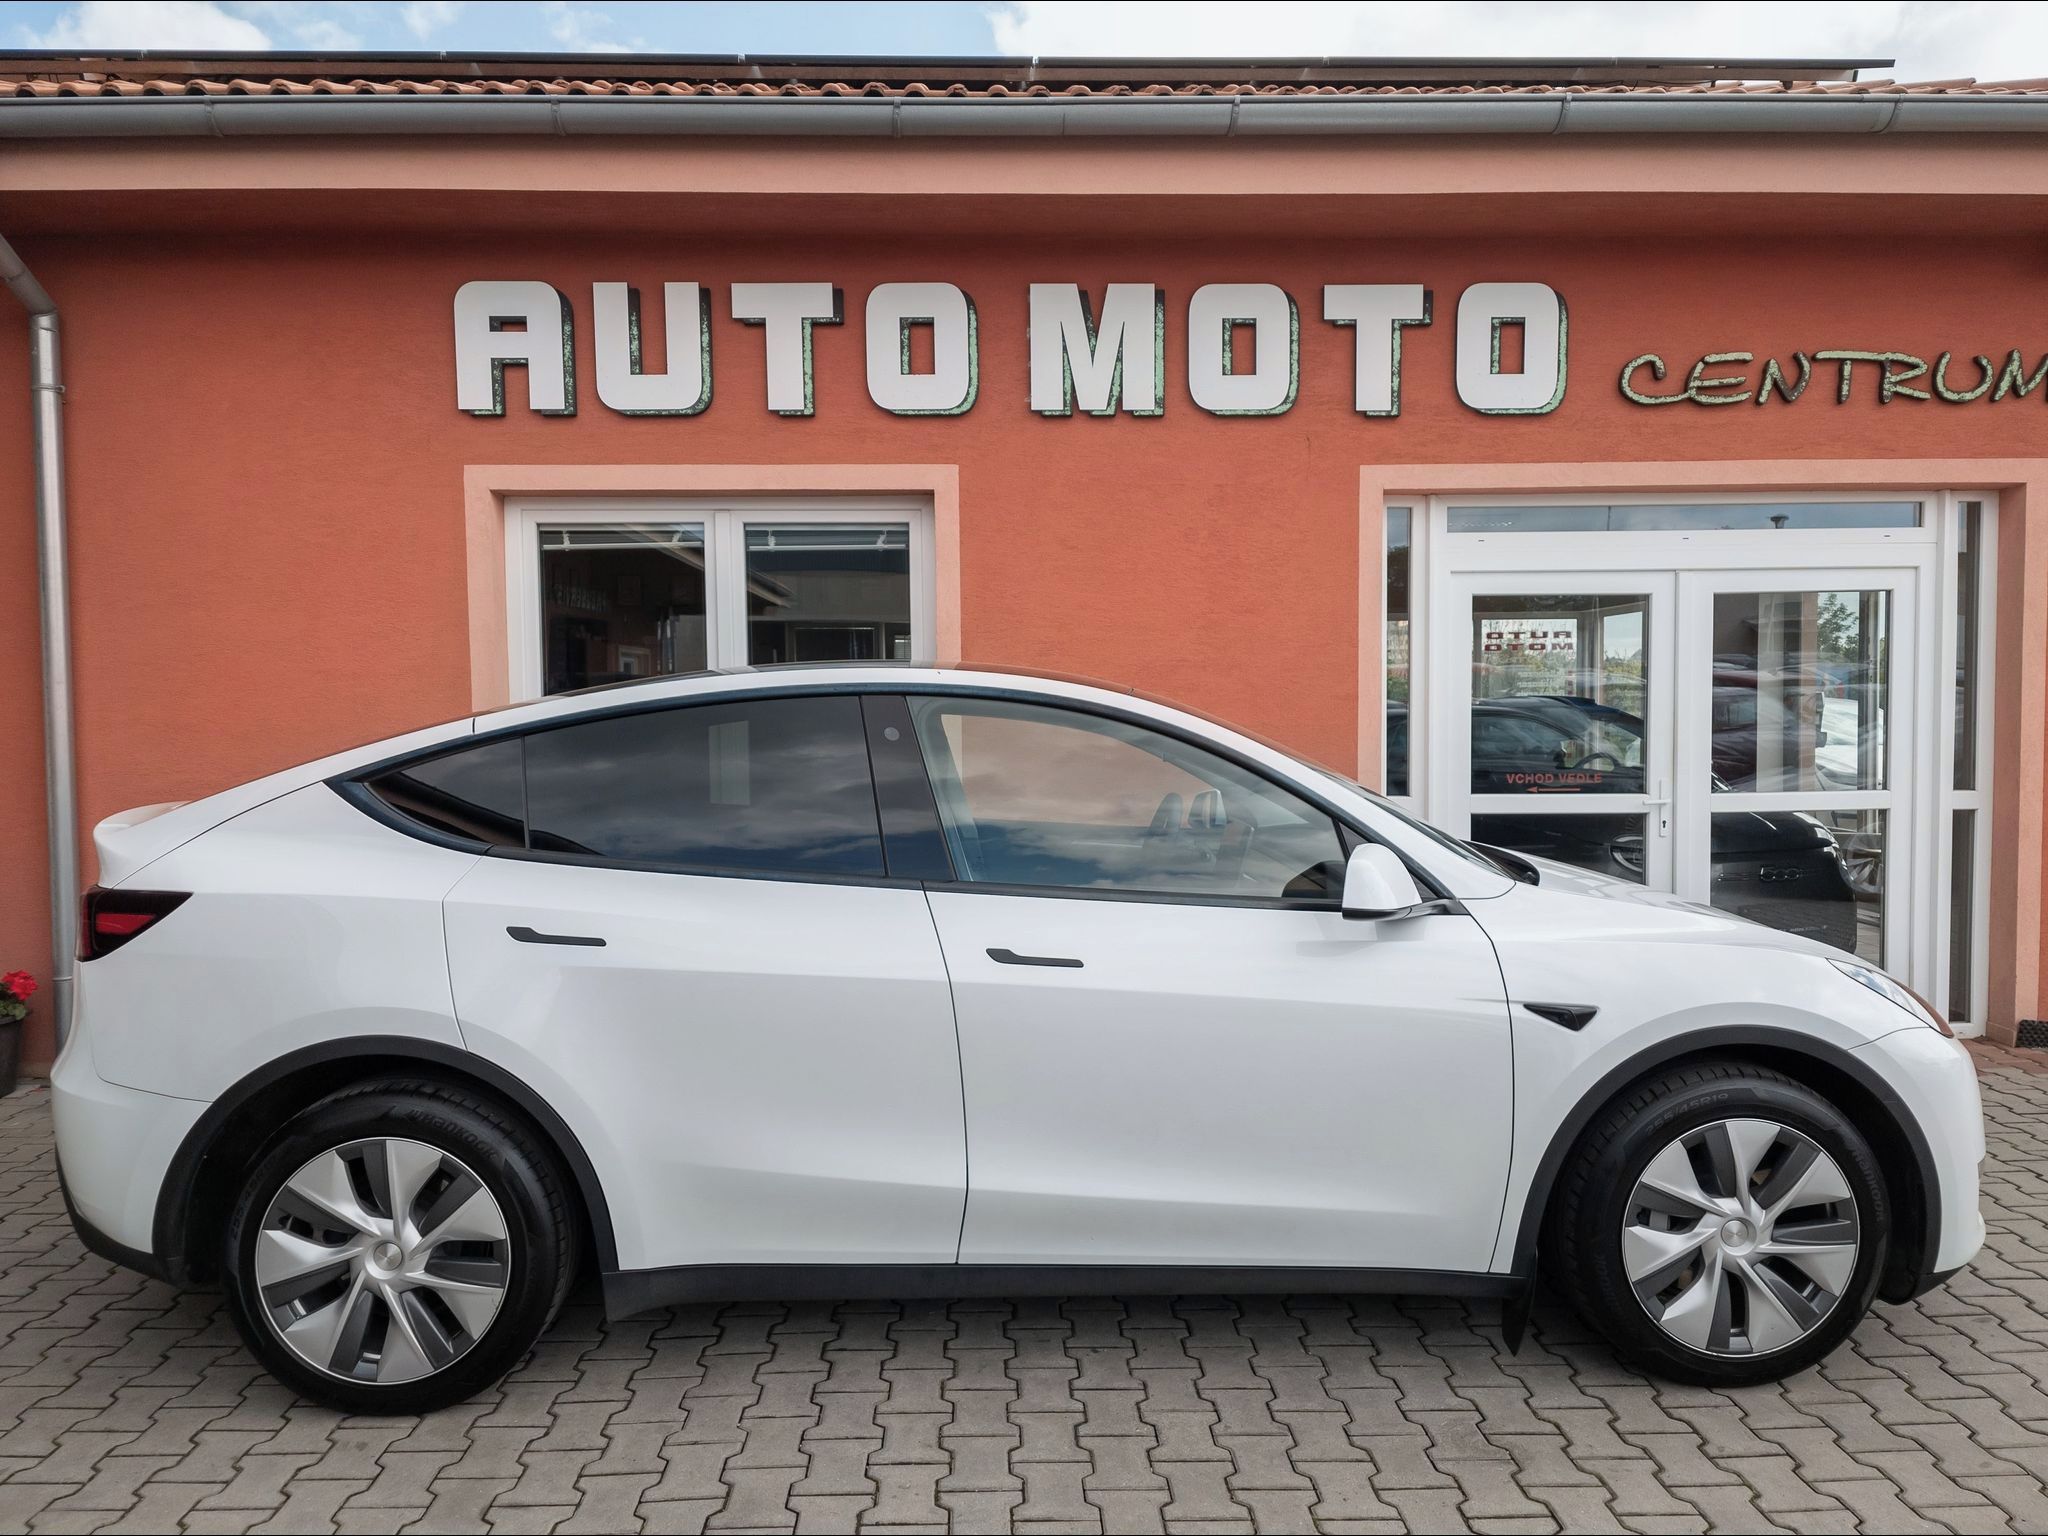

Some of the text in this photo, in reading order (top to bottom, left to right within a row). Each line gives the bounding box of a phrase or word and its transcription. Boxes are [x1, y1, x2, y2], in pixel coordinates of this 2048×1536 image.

[453, 280, 2048, 417] AUTO MOTO CENTRUM
[1506, 773, 1603, 784] VCHOD VEDLE
